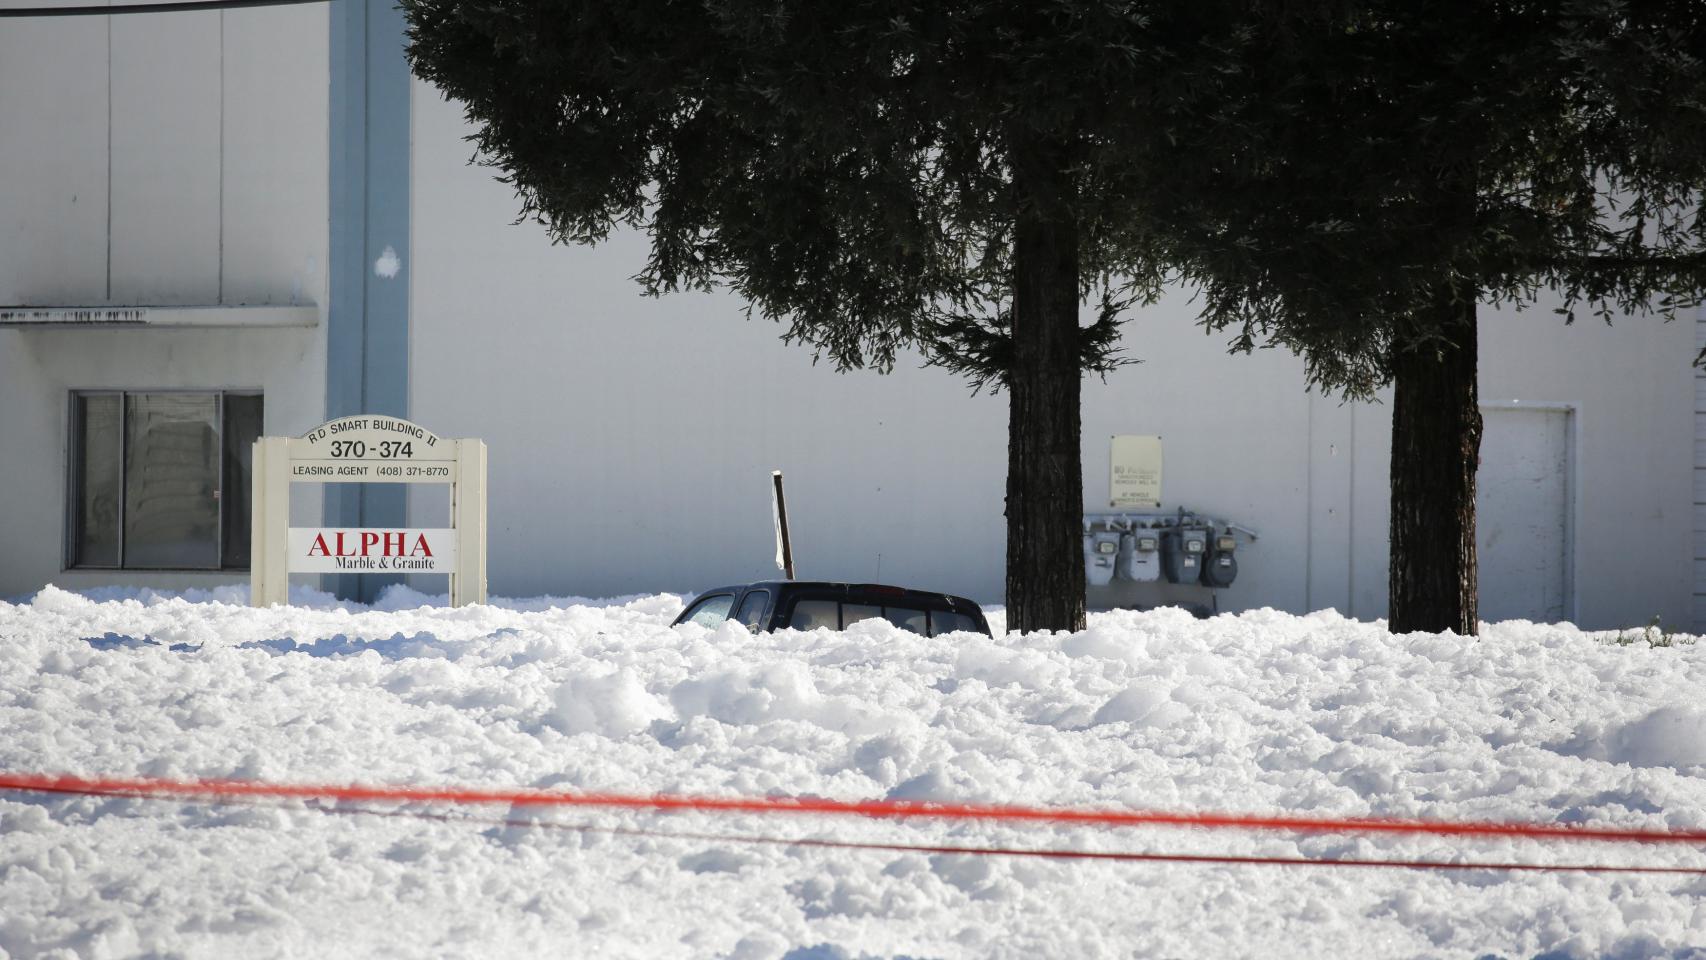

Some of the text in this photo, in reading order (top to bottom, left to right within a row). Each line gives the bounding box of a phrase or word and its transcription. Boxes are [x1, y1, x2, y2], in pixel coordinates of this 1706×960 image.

[330, 419, 369, 435] SMART
[373, 419, 424, 439] BUILDING
[293, 466, 449, 477] LEASING AGENT (408) 371-8770
[306, 532, 434, 557] ALPHA
[335, 556, 435, 570] Marble & Granite
